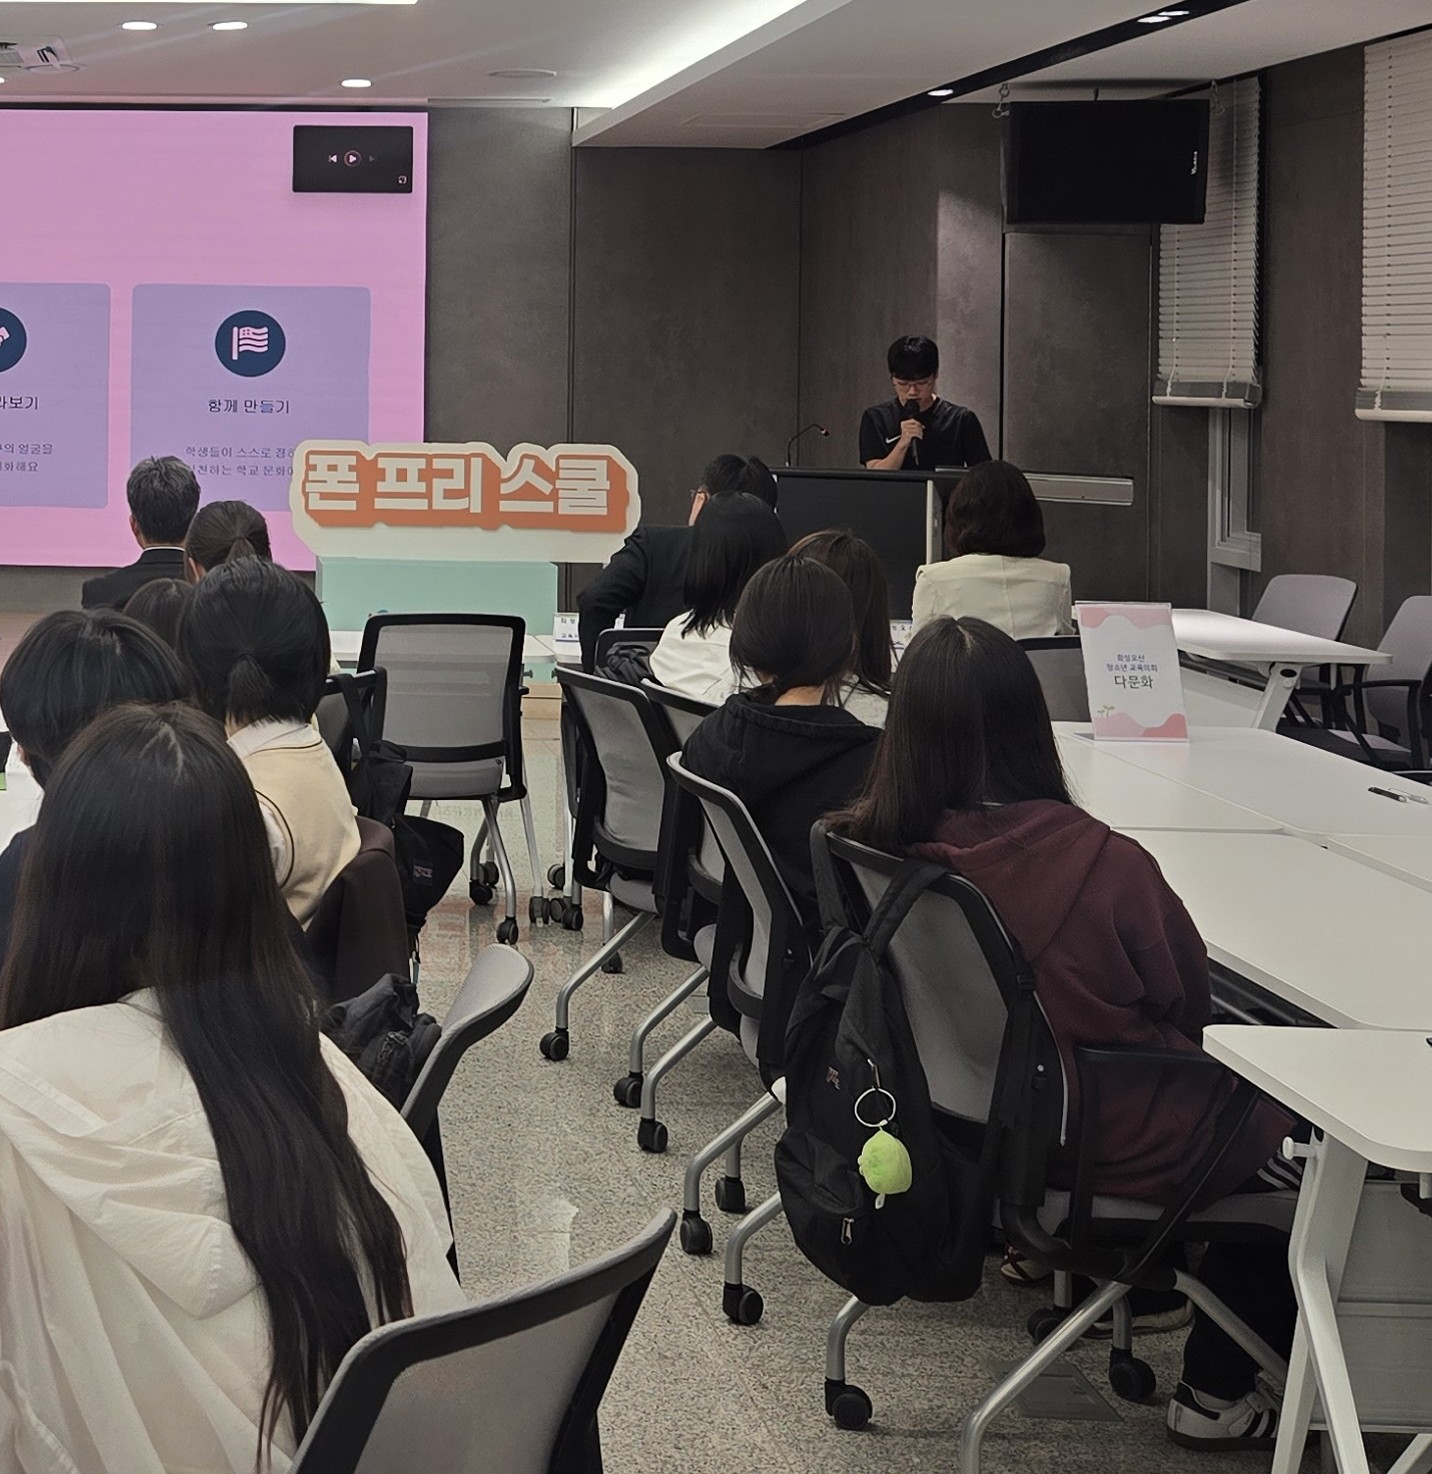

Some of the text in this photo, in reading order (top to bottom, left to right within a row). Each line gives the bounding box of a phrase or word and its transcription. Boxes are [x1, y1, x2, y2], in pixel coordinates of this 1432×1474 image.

[208, 399, 290, 415] 함께 만들기
[192, 464, 232, 476] 천하는
[305, 454, 611, 516] 폰 프리 스쿨
[1113, 674, 1154, 690] 다문화
